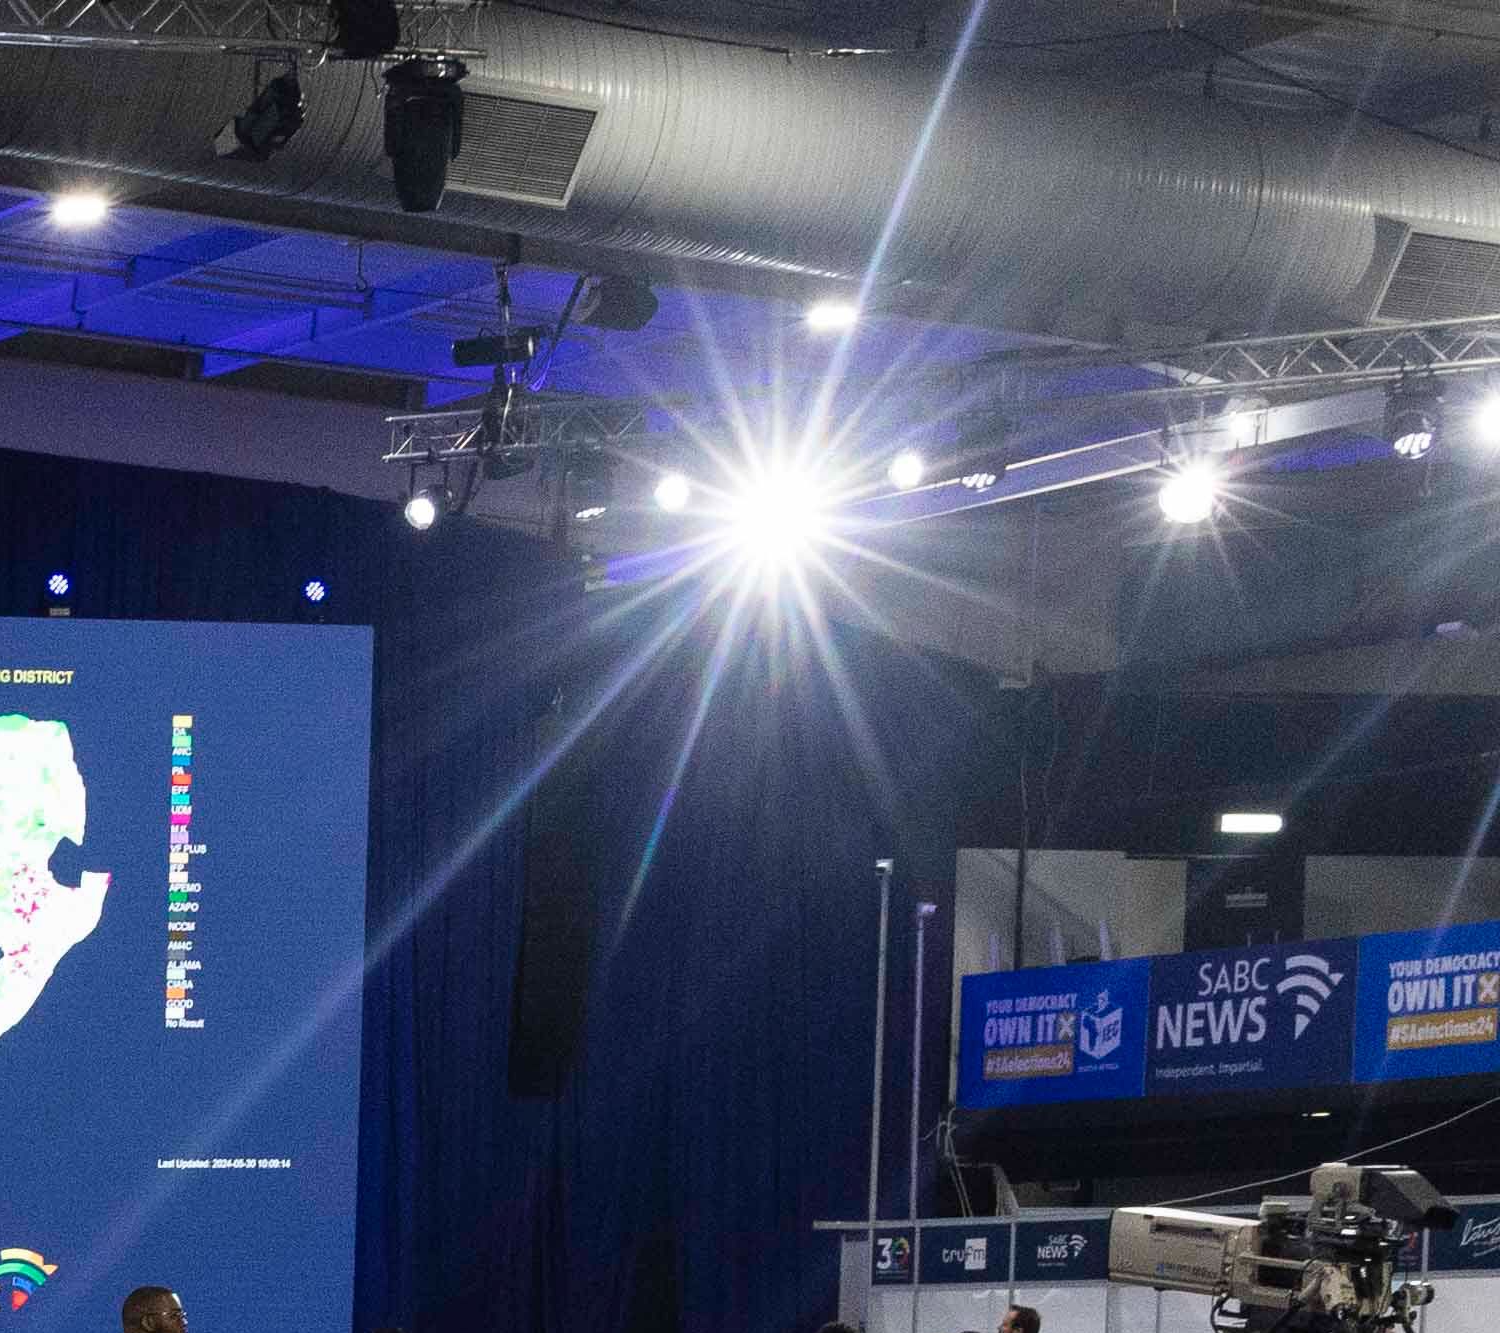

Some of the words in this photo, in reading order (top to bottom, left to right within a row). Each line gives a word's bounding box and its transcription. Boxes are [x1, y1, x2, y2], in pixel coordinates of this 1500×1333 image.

[14, 670, 73, 684] DISTRICT
[1199, 957, 1271, 996] SABC
[1389, 960, 1422, 979] YOUR
[986, 999, 1013, 1014] YOUR
[1388, 978, 1445, 1013] OWN
[1452, 974, 1476, 1007] IT
[985, 1014, 1032, 1046] OWN
[1037, 1013, 1056, 1042] IT
[1156, 996, 1267, 1049] NEWS
[1390, 1016, 1493, 1043] #SAelections24
[1037, 1244, 1067, 1259] NEWS
